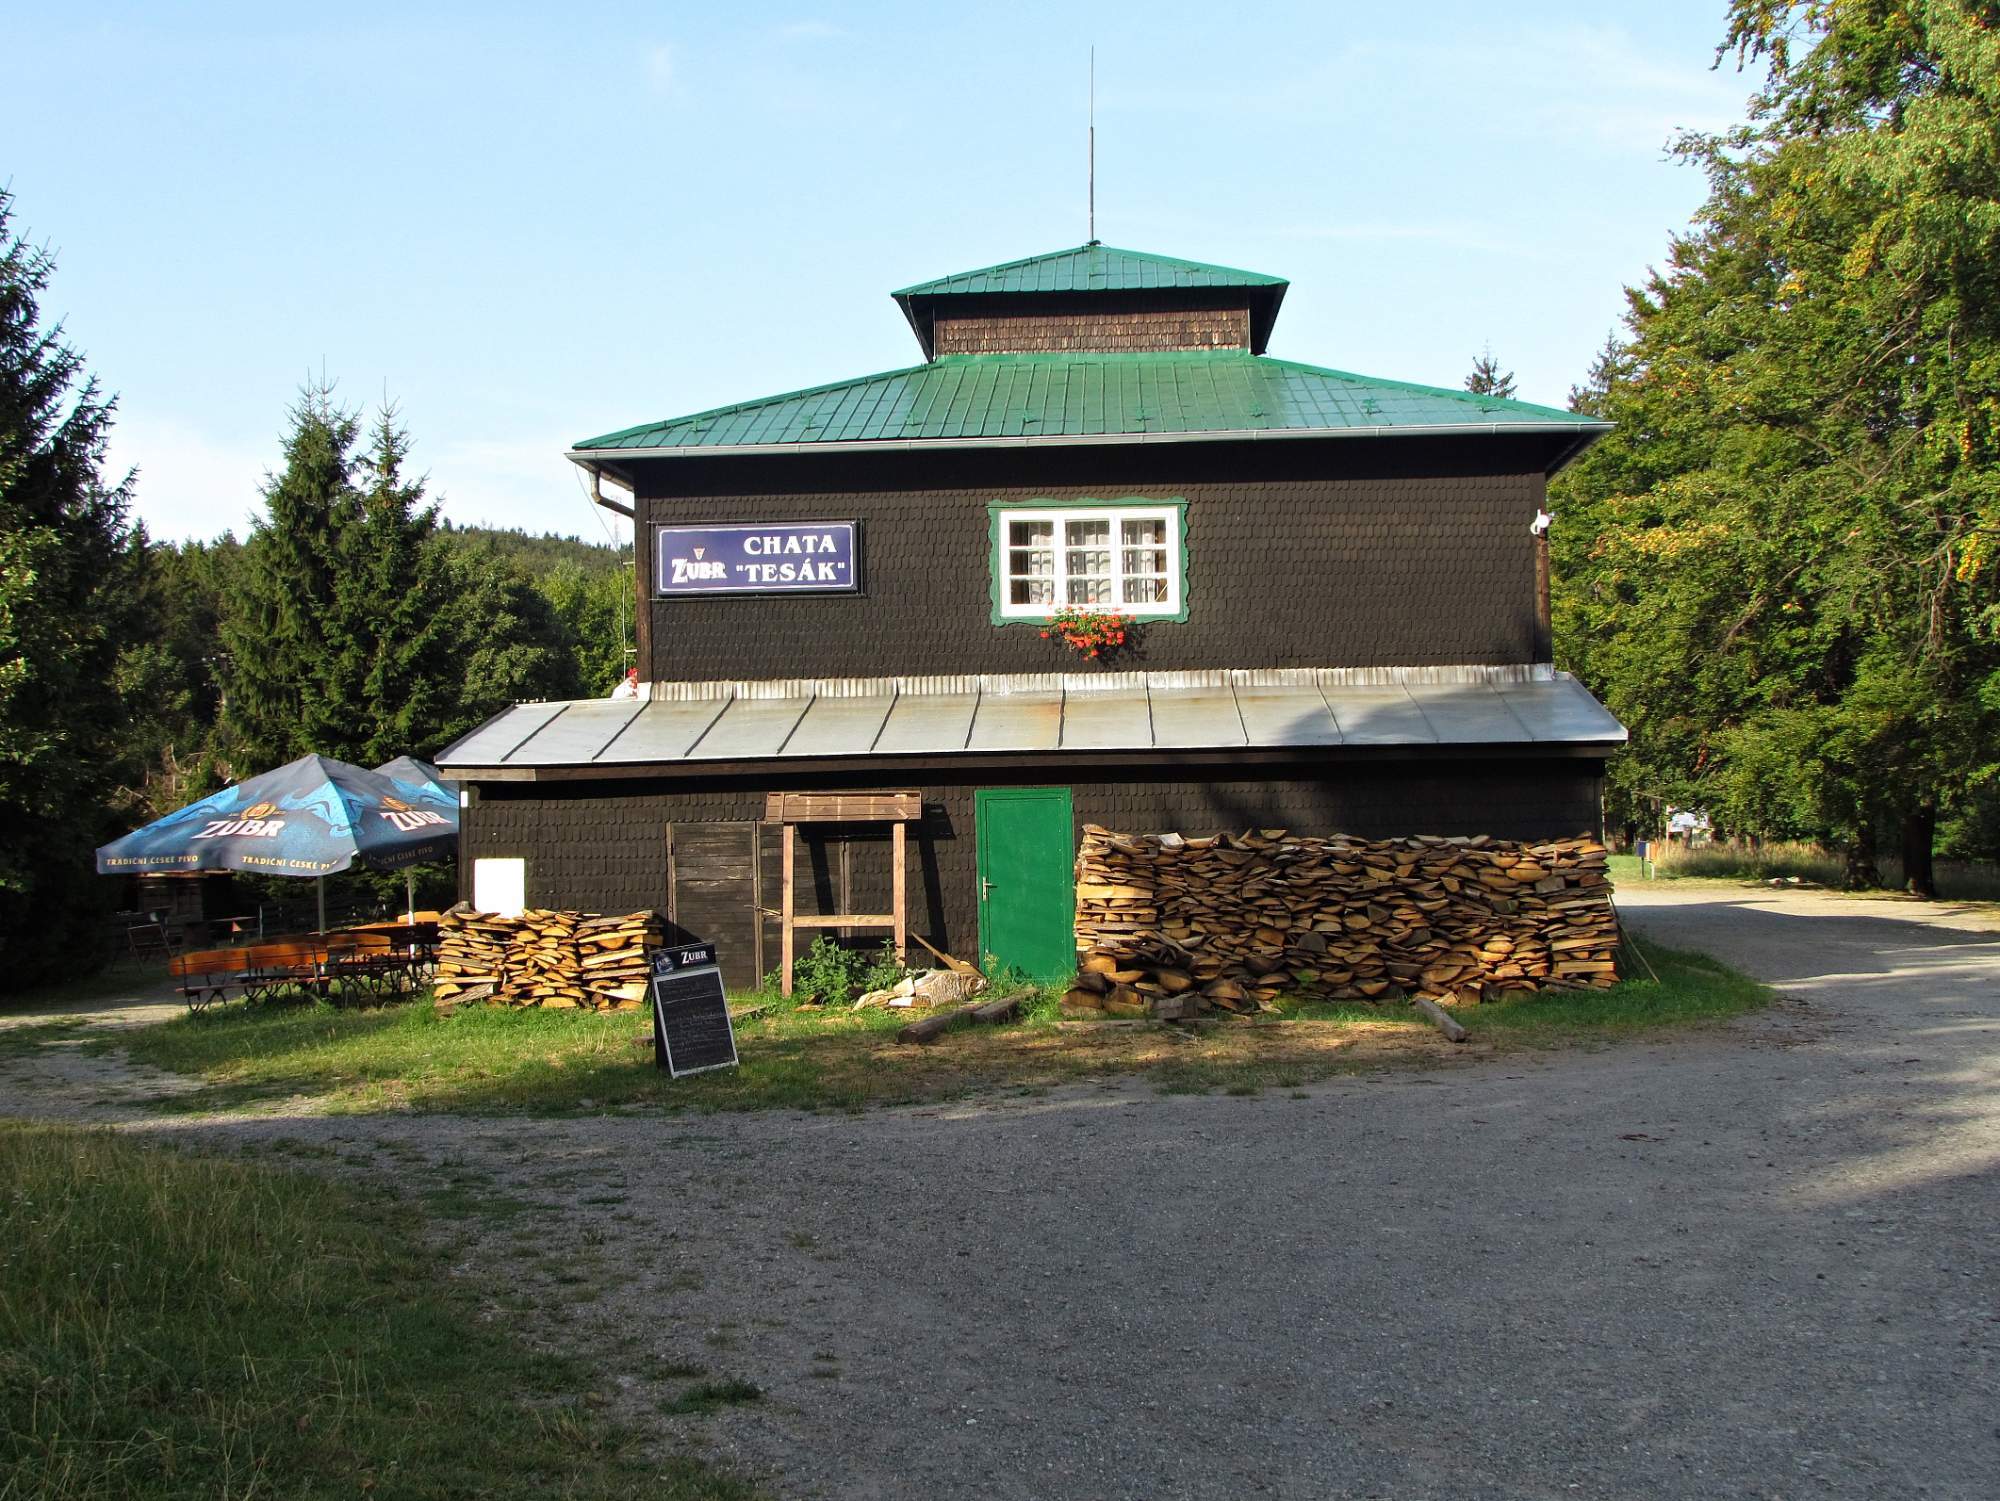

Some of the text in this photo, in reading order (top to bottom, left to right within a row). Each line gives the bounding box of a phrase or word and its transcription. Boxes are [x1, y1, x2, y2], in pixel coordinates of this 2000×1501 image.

[743, 534, 837, 555] CHATA
[671, 558, 727, 584] ZUBR
[191, 819, 286, 839] ZUBR
[681, 950, 708, 965] ZUBR
